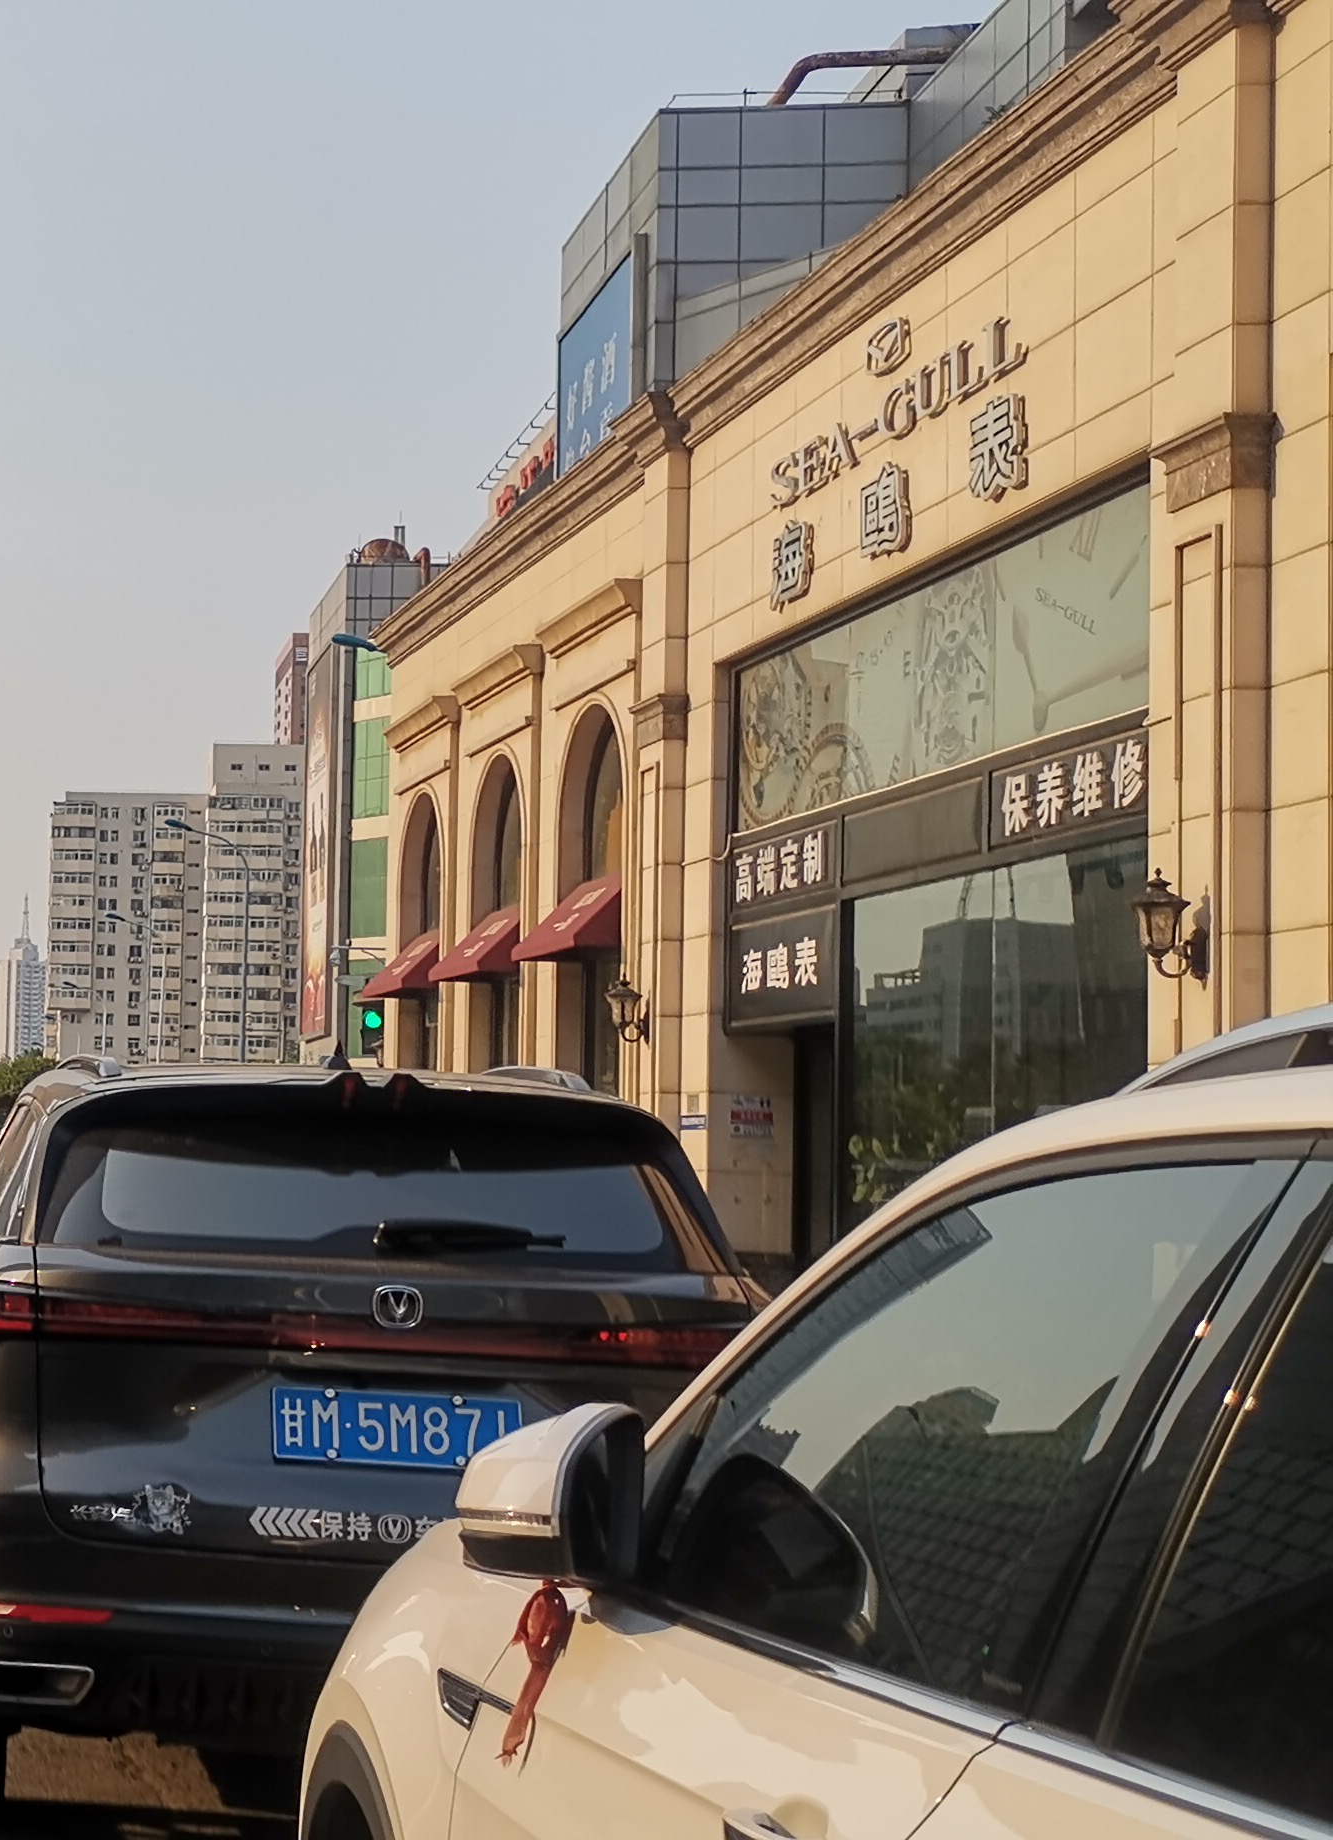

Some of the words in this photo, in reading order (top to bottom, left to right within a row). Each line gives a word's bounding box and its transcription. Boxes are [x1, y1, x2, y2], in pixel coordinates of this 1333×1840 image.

[770, 315, 1029, 509] SEA-GULL
[1035, 587, 1096, 636] SEA-GULL
[1001, 739, 1147, 835] 保养维修
[735, 831, 823, 903] 高端定制
